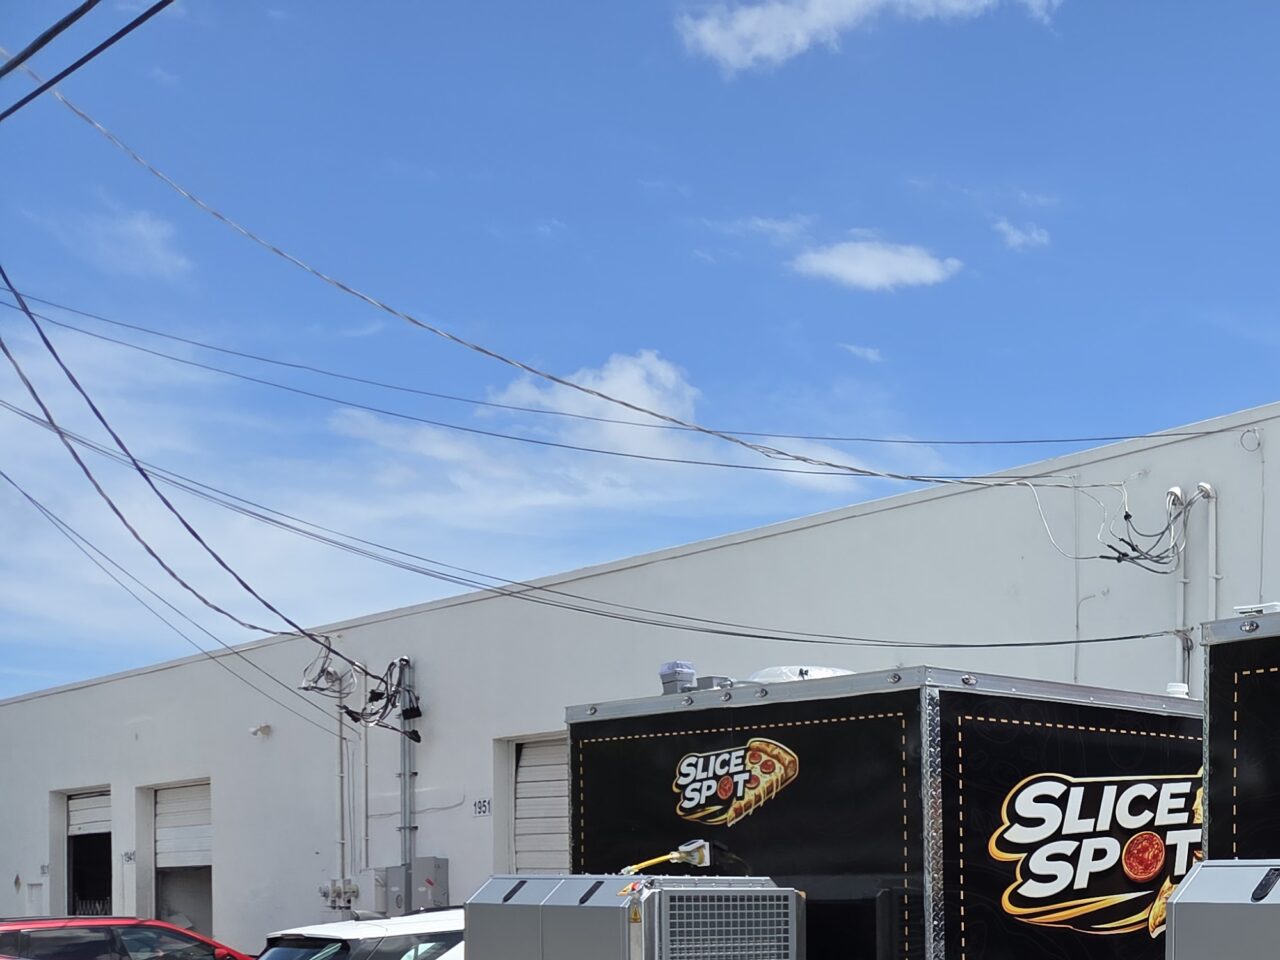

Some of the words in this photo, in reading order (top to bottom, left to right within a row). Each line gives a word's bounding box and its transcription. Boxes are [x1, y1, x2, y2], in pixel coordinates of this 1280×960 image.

[676, 749, 745, 785] SLICE
[473, 799, 491, 815] 1951
[680, 772, 750, 808] SPOT
[1002, 780, 1192, 844] SLICE
[1016, 828, 1203, 898] SPOT
